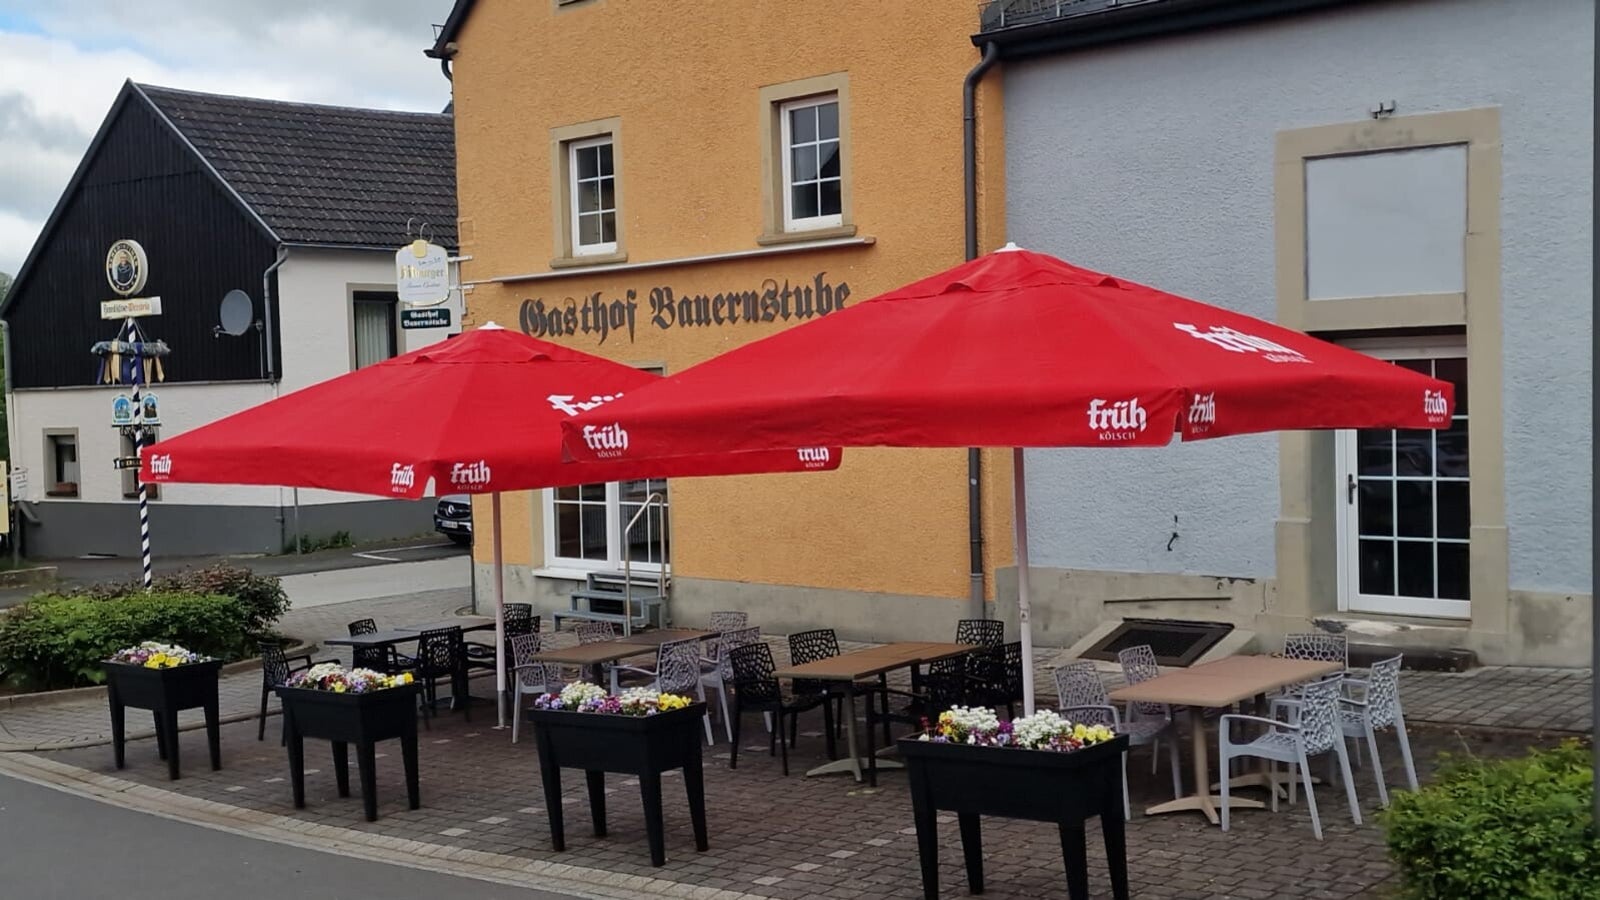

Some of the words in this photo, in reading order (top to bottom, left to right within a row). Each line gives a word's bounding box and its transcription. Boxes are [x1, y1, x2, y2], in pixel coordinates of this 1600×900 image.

[519, 290, 636, 345] Gasthof
[649, 272, 850, 330] Bauernstube
[1086, 396, 1147, 432] früh
[583, 421, 629, 450] früh
[1099, 431, 1136, 441] KÖLSCH
[450, 459, 491, 485] früh
